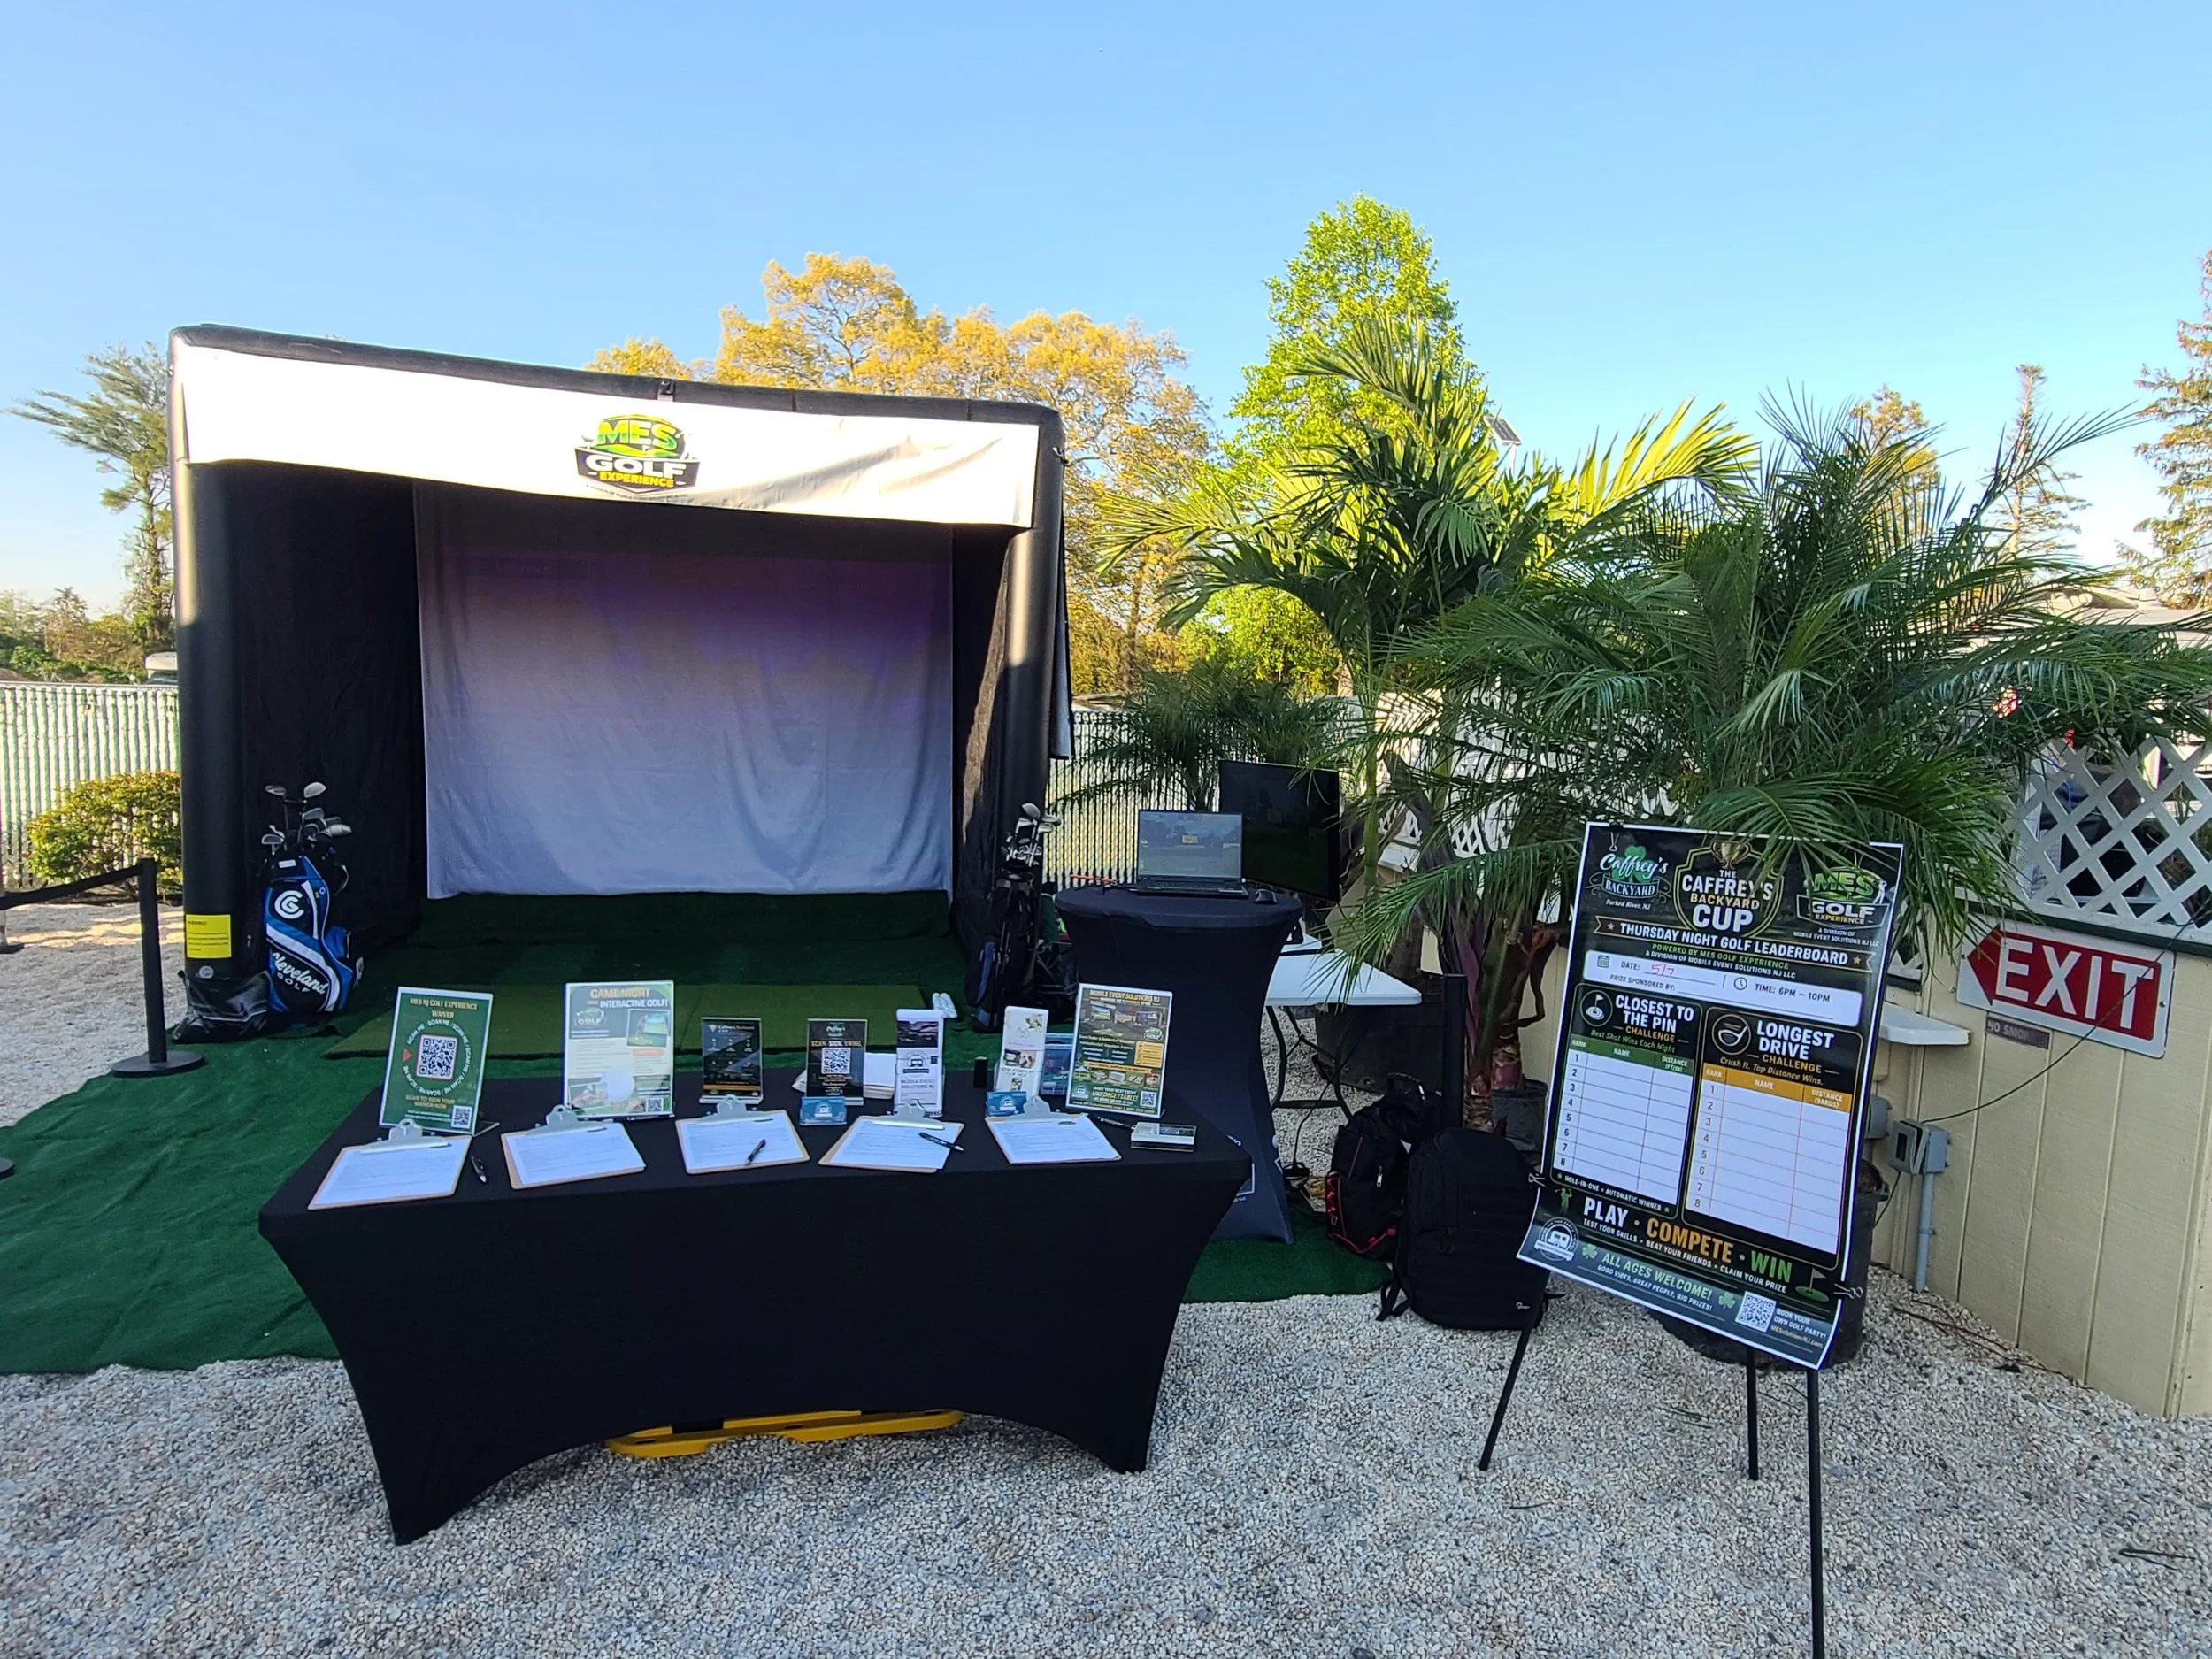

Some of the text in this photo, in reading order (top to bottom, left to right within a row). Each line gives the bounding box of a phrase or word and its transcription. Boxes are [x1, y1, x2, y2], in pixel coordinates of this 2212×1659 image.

[597, 419, 677, 450] MES
[586, 454, 687, 479] GOLF
[599, 471, 674, 488] EXPERIENCE
[1600, 854, 1669, 879] Caffrey's
[1719, 869, 1737, 879] THE
[1605, 879, 1656, 897] BACKYARD
[1682, 874, 1774, 900] CAFFREY'S
[1814, 872, 1874, 897] MES
[1606, 899, 1624, 908] Forked
[1625, 901, 1641, 910] River,
[1690, 893, 1760, 910] BACKYARD
[1809, 901, 1876, 918] GOLF
[1692, 904, 1754, 933] CUP
[1815, 914, 1865, 926] EXPERIENCE
[1619, 922, 1848, 965] THURSDAY NIGHT GOLF LEADERBOARD
[1831, 935, 1860, 945] SOLUTIONS
[1651, 951, 1678, 961] DIVISION
[1688, 956, 1711, 966] MOBILE
[1712, 960, 1733, 970] EVENT
[1734, 964, 1771, 975] SOLUTIONS
[1652, 943, 1686, 954] POWERED
[1717, 953, 1737, 962] GOLF
[1739, 956, 1790, 970] EXPERIENCE
[273, 952, 329, 994] Cleveland
[1621, 961, 1640, 971] DATE:
[277, 972, 310, 993] GOLF
[1609, 973, 1626, 983] PRIZE
[1627, 977, 1664, 989] SPONSORED
[1995, 937, 2154, 1029] EXIT
[590, 987, 651, 999] GAME NIGHT
[1755, 983, 1831, 1002] TIME: 6PM 10PM
[444, 1000, 478, 1010] EXPERIENCE
[600, 999, 645, 1008] INTERACTIVE
[647, 998, 668, 1007] GOLF!
[1615, 994, 1694, 1021] CLOSEST TO
[1623, 1010, 1677, 1033] THE PIN
[1987, 1019, 2001, 1033] NO
[1625, 1026, 1675, 1042] CHALLENGE
[1756, 1020, 1835, 1048] LONGEST
[1571, 1039, 1586, 1048] RANK
[1606, 1032, 1621, 1041] Shot
[1622, 1035, 1638, 1045] Wins
[1639, 1040, 1655, 1048] Each
[1656, 1042, 1676, 1054] Night
[1758, 1037, 1810, 1060] DRIVE
[1614, 1048, 1630, 1057] NAME
[1662, 1056, 1688, 1067] DISTANCE
[1762, 1054, 1822, 1073] CHALLENGE
[1706, 1069, 1723, 1078] RANK
[1720, 1056, 1741, 1068] Crush
[1753, 1063, 1766, 1073] Top
[1768, 1066, 1801, 1080] Distance
[1802, 1073, 1824, 1086] Wins.
[1710, 1085, 1715, 1094] 1
[1755, 1079, 1774, 1090] NAME
[1812, 1090, 1844, 1102] DISTANCE
[1815, 1097, 1839, 1109] (YARDS)
[1708, 1101, 1713, 1110] 2
[1706, 1118, 1711, 1126] 3
[1703, 1133, 1709, 1143] 4
[1701, 1150, 1707, 1159] 5
[1699, 1166, 1705, 1175] 6
[1564, 1175, 1662, 1211] HOLE-IN-ONE AUTOMATIC WINNER
[1697, 1182, 1703, 1191] 7
[1694, 1199, 1701, 1208] 8
[1583, 1196, 1793, 1283] PLAY COMPETE WIN
[1584, 1218, 1787, 1294] TEST YOUR SKILLS BEAT YOUR FRIENDS CLAIM YOUR PRIZE
[1601, 1253, 1713, 1301] ALL AGES WELCOME!
[1597, 1264, 1713, 1310] GOOD VIBES, GREAT PEOPLE, BIG PRIZES!
[1773, 1317, 1788, 1325] OWN
[1804, 1326, 1827, 1340] PARTY!
